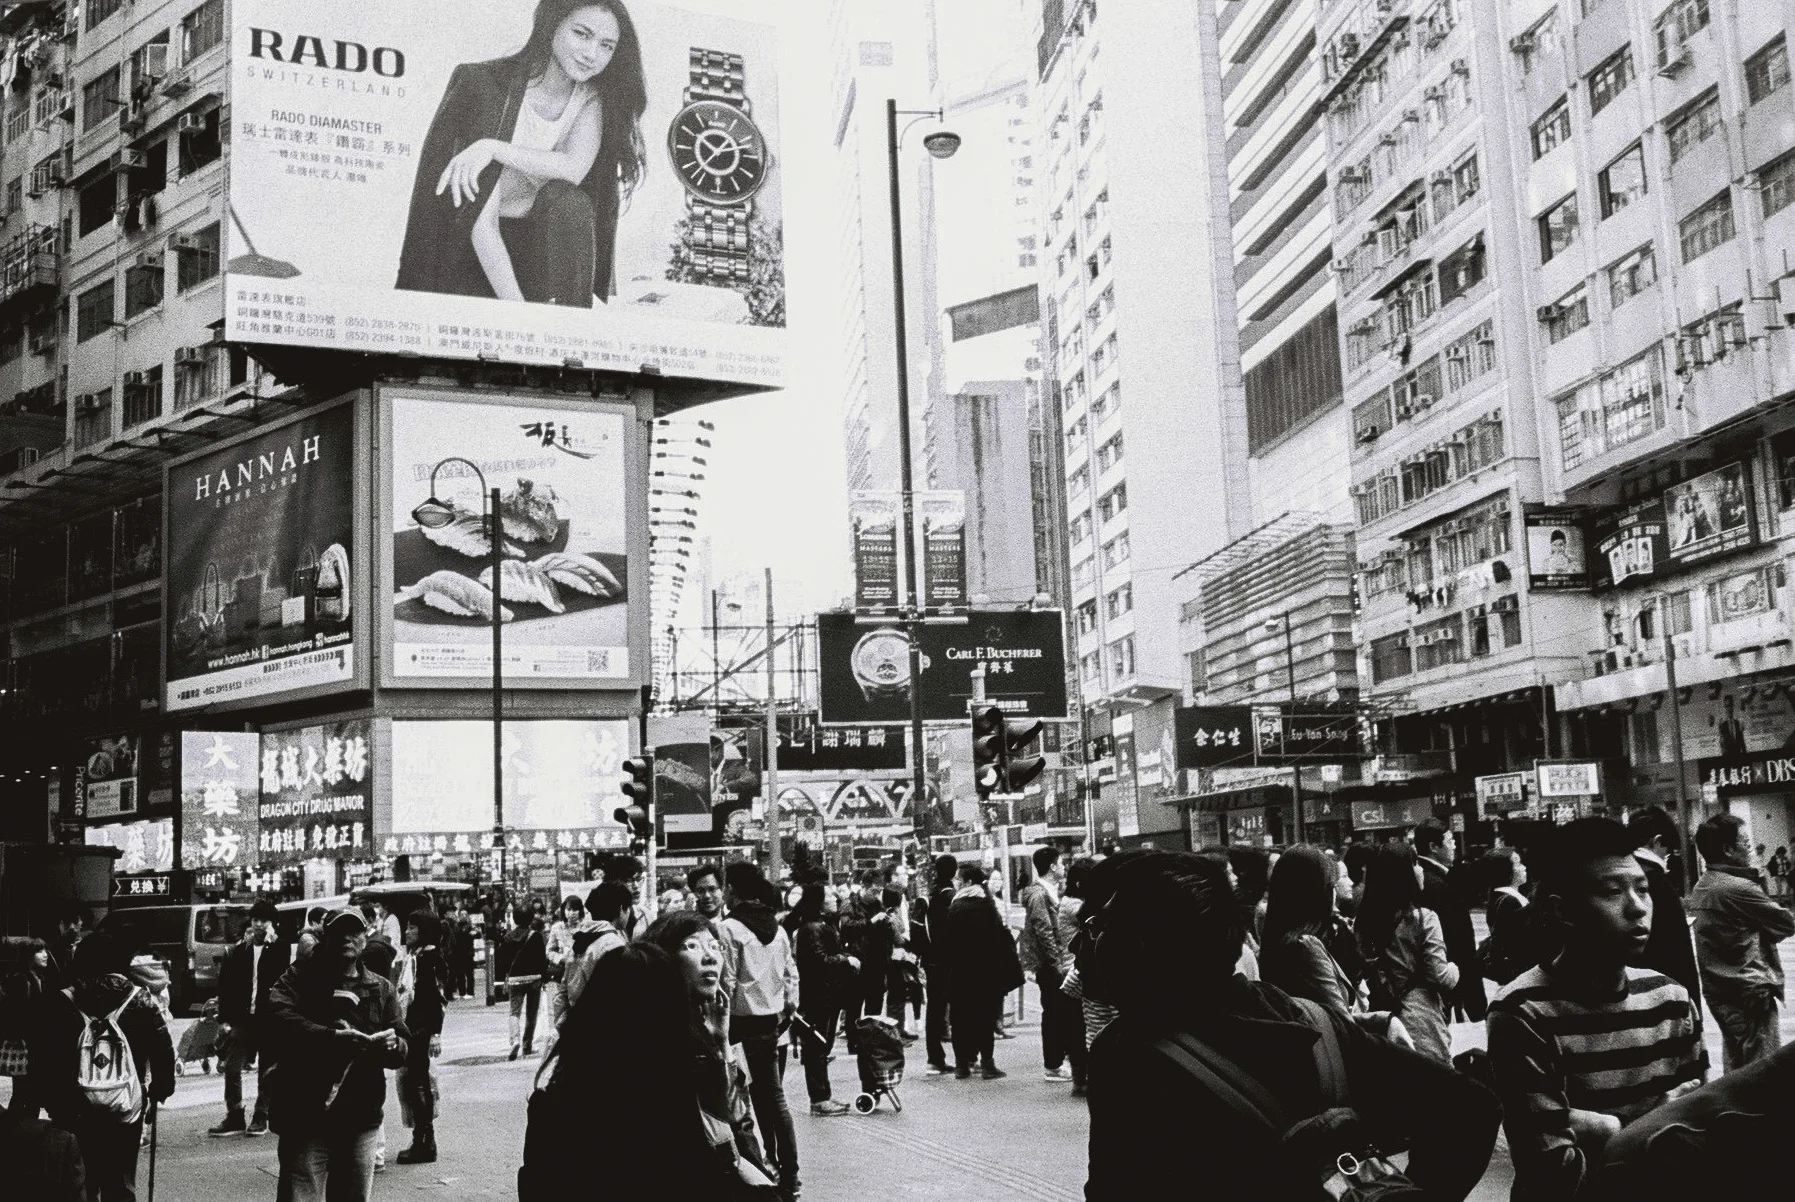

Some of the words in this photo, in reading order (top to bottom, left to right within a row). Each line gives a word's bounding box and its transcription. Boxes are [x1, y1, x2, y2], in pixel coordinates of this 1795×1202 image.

[248, 27, 405, 78] RADO
[247, 65, 406, 98] SWITZERLAND
[271, 109, 306, 126] RADO
[309, 114, 382, 135] DIAMASTER
[195, 435, 320, 501] HANNAH
[946, 647, 975, 660] CARL
[976, 646, 985, 659] F.
[986, 646, 1043, 659] BUCHERER
[202, 735, 242, 866] 大藥坊
[260, 801, 292, 819] DRAGON
[292, 799, 310, 817] CITY
[310, 798, 333, 815] DRUG
